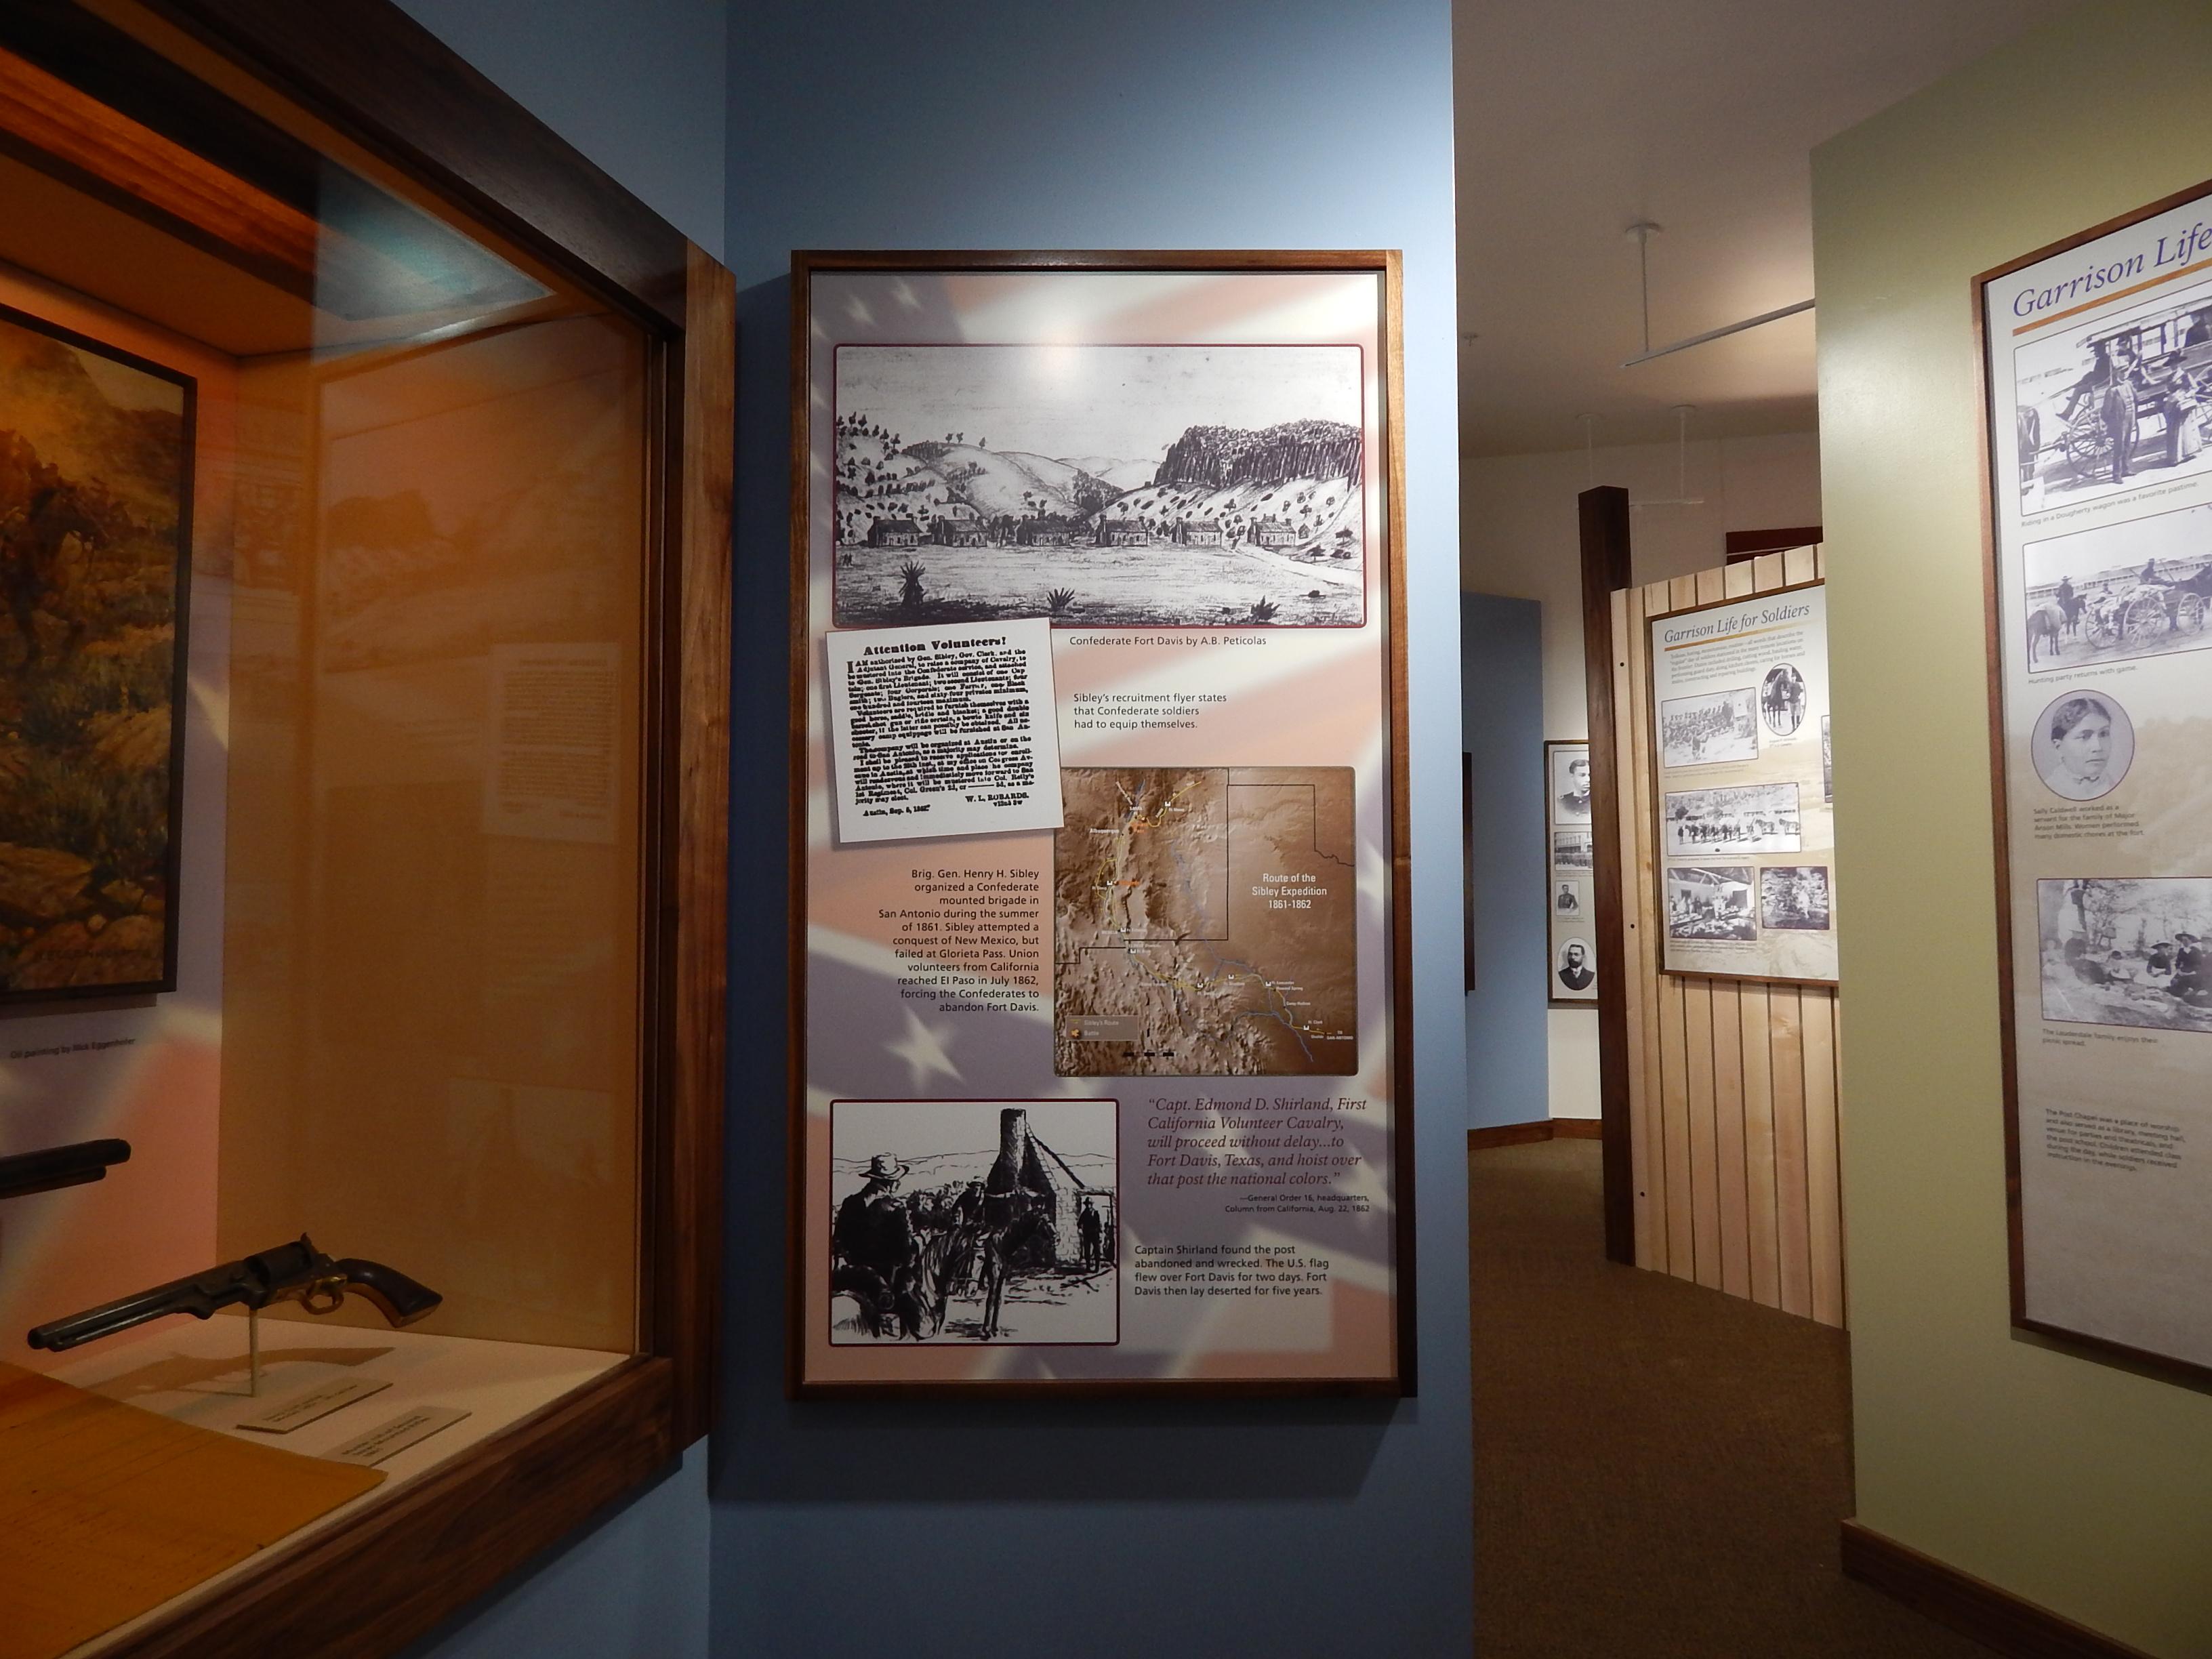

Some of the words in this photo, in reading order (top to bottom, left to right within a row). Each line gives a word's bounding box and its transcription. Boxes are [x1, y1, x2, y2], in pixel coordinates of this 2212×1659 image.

[2013, 253, 2144, 316] Garrison
[2153, 222, 2212, 267] Life
[1664, 624, 1714, 643] Garrison
[1717, 617, 1738, 635] Life
[1740, 614, 1758, 632] for
[1761, 604, 1810, 624] Soldiers
[863, 643, 926, 655] Attention
[931, 636, 1006, 650] Volunteers!
[1070, 636, 1131, 644] Confederate
[1158, 636, 1183, 644] Davis
[1187, 636, 1197, 647] by
[1224, 636, 1266, 644] Peticolas
[1074, 693, 1109, 704] Sibley's
[1113, 693, 1170, 701] recruitment
[1174, 693, 1195, 703] flyer
[1074, 706, 1094, 715] that
[1098, 706, 1159, 715] Confederate
[1162, 706, 1199, 715] soldiers
[1075, 720, 1092, 728] had
[1110, 720, 1137, 730] equip
[1141, 720, 1197, 728] themselves.
[912, 869, 934, 880] Brig.
[938, 869, 960, 878] Gen.
[964, 869, 994, 880] Henry
[997, 869, 1006, 878] H.
[1010, 869, 1039, 880] Sibley
[1263, 874, 1288, 882] Route
[1291, 873, 1299, 882] of
[1302, 874, 1315, 882] the
[915, 882, 964, 893] organized
[977, 882, 1039, 891] Confederate
[1252, 886, 1279, 897] Sibley
[1282, 886, 1327, 897] Expedition
[940, 896, 985, 905] mounted
[989, 896, 1026, 907] brigade
[1030, 896, 1038, 904] in
[1269, 900, 1311, 908] 1861-1862
[879, 909, 896, 918] San
[900, 909, 940, 918] Antonio
[944, 909, 976, 920] during
[980, 909, 996, 918] the
[902, 922, 912, 931] of
[917, 923, 941, 931] 1861.
[945, 922, 974, 933] Sibley
[978, 922, 1029, 933] attempted
[893, 937, 938, 947] conquest
[941, 936, 951, 944] of
[956, 936, 977, 944] New
[981, 936, 1018, 945] Mexico,
[1023, 936, 1038, 944] but
[895, 949, 923, 958] failed
[940, 949, 979, 958] Glorieta
[983, 949, 1005, 958] Pass.
[1009, 949, 1038, 958] Union
[908, 963, 960, 971] volunteers
[964, 962, 987, 971] from
[991, 962, 1038, 971] California
[898, 976, 937, 985] reached
[953, 977, 975, 985] Paso
[979, 976, 987, 984] in
[991, 976, 1009, 987] July
[1014, 976, 1038, 985] 1862,
[901, 989, 936, 1000] forcing
[939, 989, 956, 998] the
[959, 989, 1025, 998] Confederates
[939, 1002, 983, 1011] abandon
[987, 1003, 1006, 1011] Fort
[1010, 1002, 1038, 1011] Davis.
[1195, 1098, 1251, 1110] Edmond
[1255, 1099, 1269, 1110] D.
[1273, 1098, 1332, 1111] Shirland,
[1337, 1098, 1366, 1110] First
[1148, 1117, 1215, 1132] California
[1221, 1117, 1283, 1129] Volunteer
[1287, 1116, 1343, 1132] Cavalry,
[1148, 1135, 1172, 1147] will
[1174, 1135, 1226, 1151] proceed
[1229, 1135, 1280, 1147] without
[1284, 1135, 1344, 1151] delay...to
[1148, 1154, 1176, 1166] Fort
[1180, 1154, 1221, 1168] Davis,
[1225, 1154, 1263, 1168] Texas,
[1268, 1153, 1294, 1166] and
[1297, 1153, 1328, 1166] hoist
[1332, 1157, 1361, 1166] over
[1148, 1172, 1174, 1185] that
[1177, 1172, 1204, 1189] post
[1208, 1172, 1227, 1185] the
[1231, 1172, 1286, 1185] national
[1135, 1246, 1173, 1255] Captain
[1177, 1246, 1217, 1254] Shirland
[1221, 1245, 1251, 1254] found
[1254, 1245, 1271, 1254] the
[1275, 1246, 1295, 1255] post
[1135, 1258, 1191, 1268] abandoned
[1195, 1259, 1214, 1267] and
[1218, 1258, 1262, 1267] wrecked.
[1265, 1258, 1284, 1267] The
[1288, 1258, 1306, 1267] U.S.
[1309, 1258, 1328, 1270] flag
[1135, 1272, 1157, 1282] flew
[1185, 1273, 1205, 1281] Fort
[1209, 1273, 1235, 1282] Davis
[1238, 1272, 1252, 1281] for
[1278, 1272, 1303, 1283] days.
[1307, 1273, 1326, 1281] Fort
[1135, 1286, 1161, 1295] Davis
[1164, 1286, 1187, 1295] then
[1191, 1286, 1204, 1297] lay
[1208, 1286, 1251, 1295] deserted
[1254, 1286, 1269, 1295] for
[1273, 1286, 1290, 1294] five
[1294, 1288, 1322, 1297] years.
